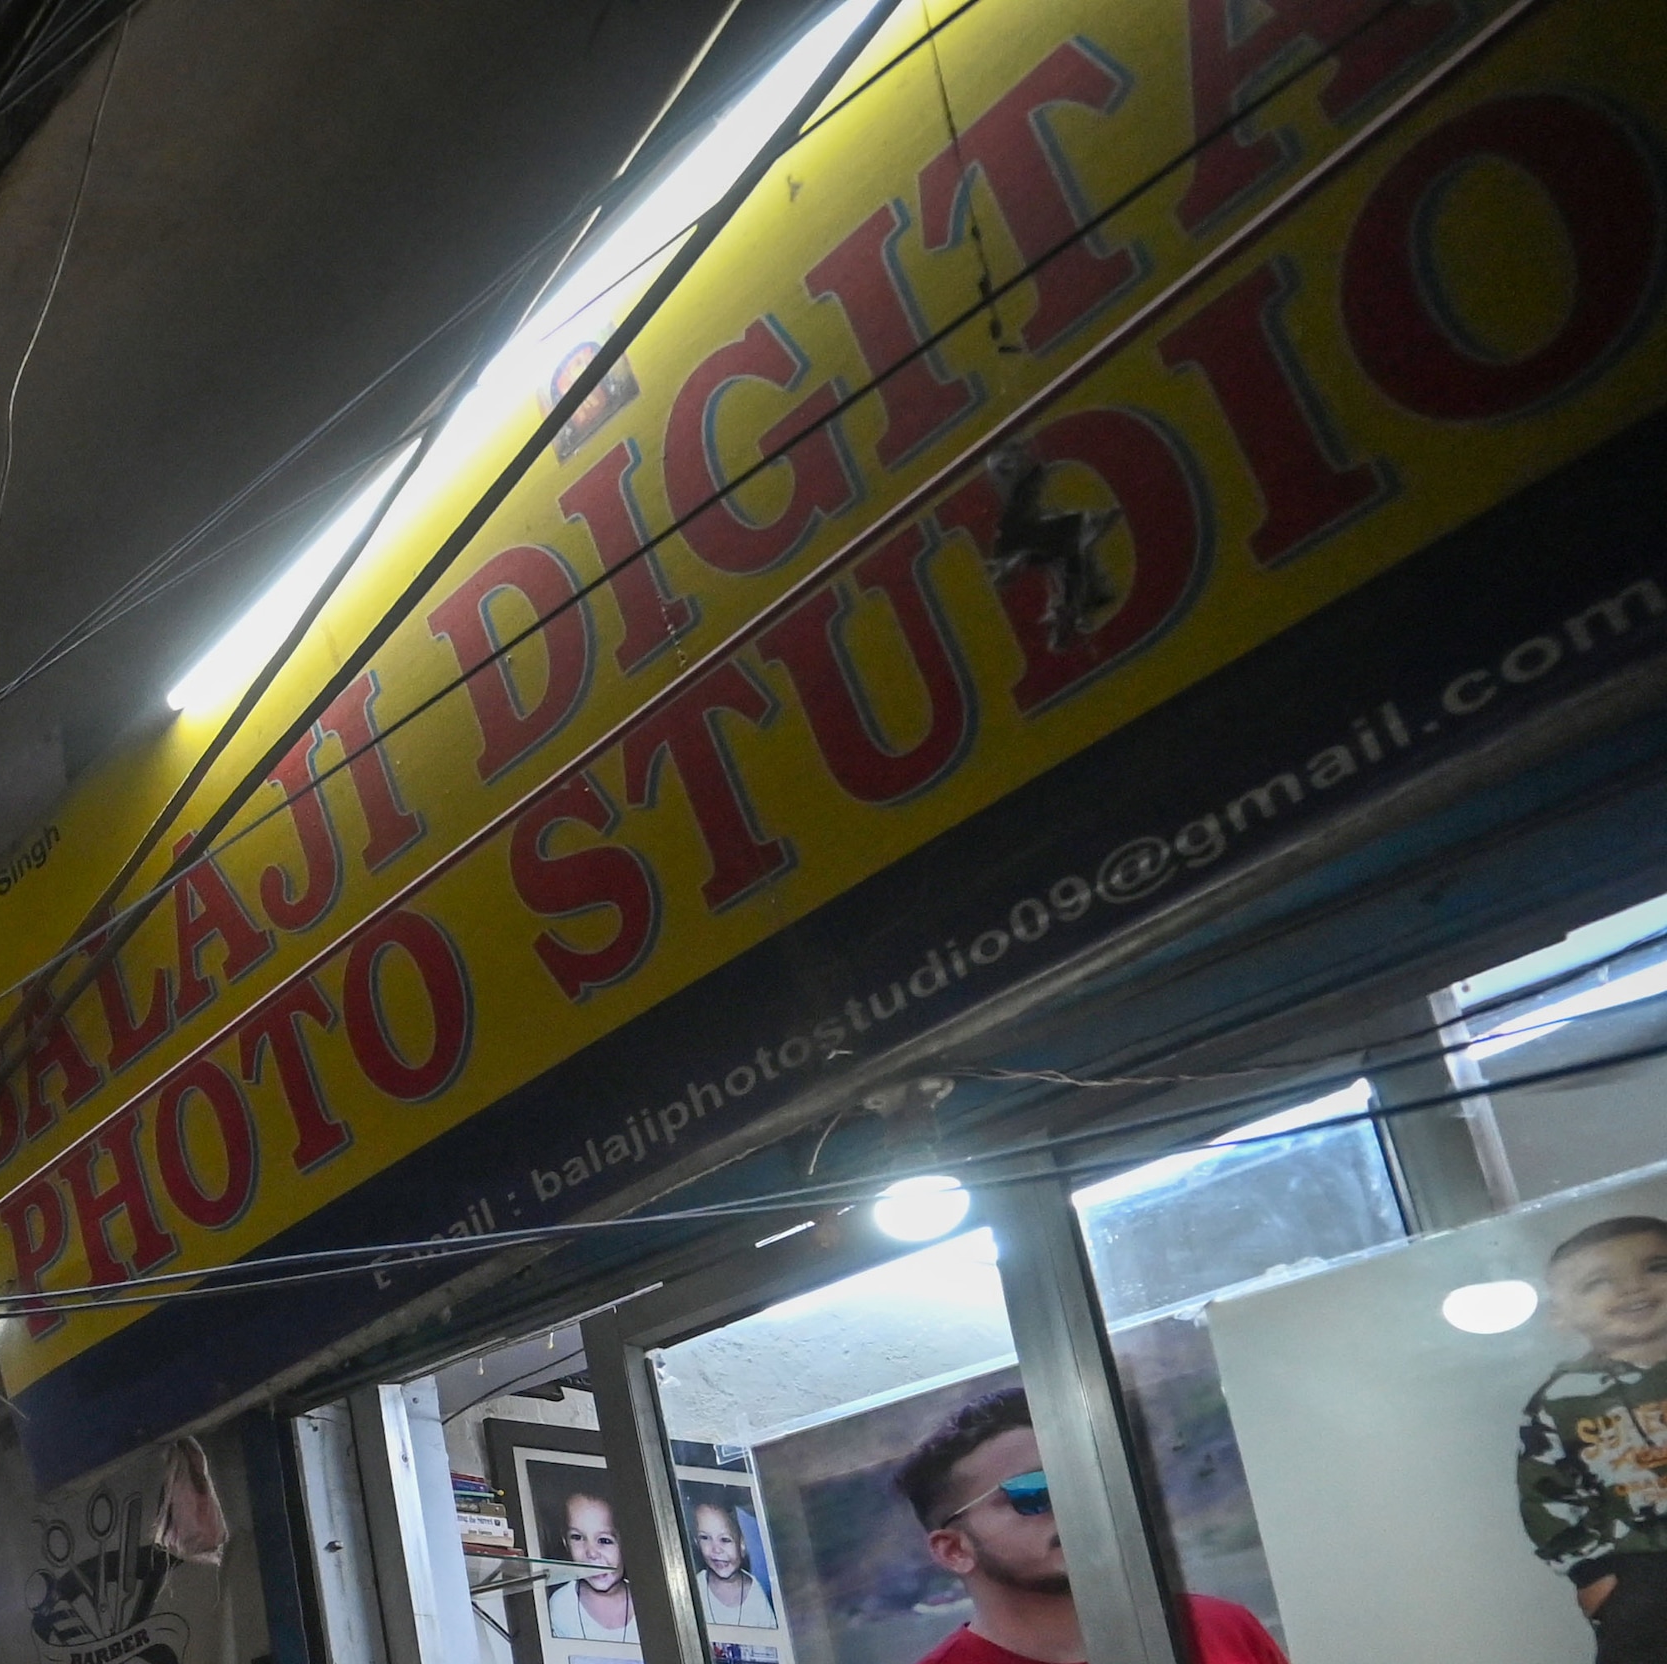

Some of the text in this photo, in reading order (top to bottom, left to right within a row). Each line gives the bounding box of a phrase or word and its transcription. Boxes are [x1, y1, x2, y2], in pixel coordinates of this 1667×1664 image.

[0, 85, 1667, 1341] PHOTO STUDIO
[533, 573, 1665, 1203] balajiphotostudio09@gmail.com
